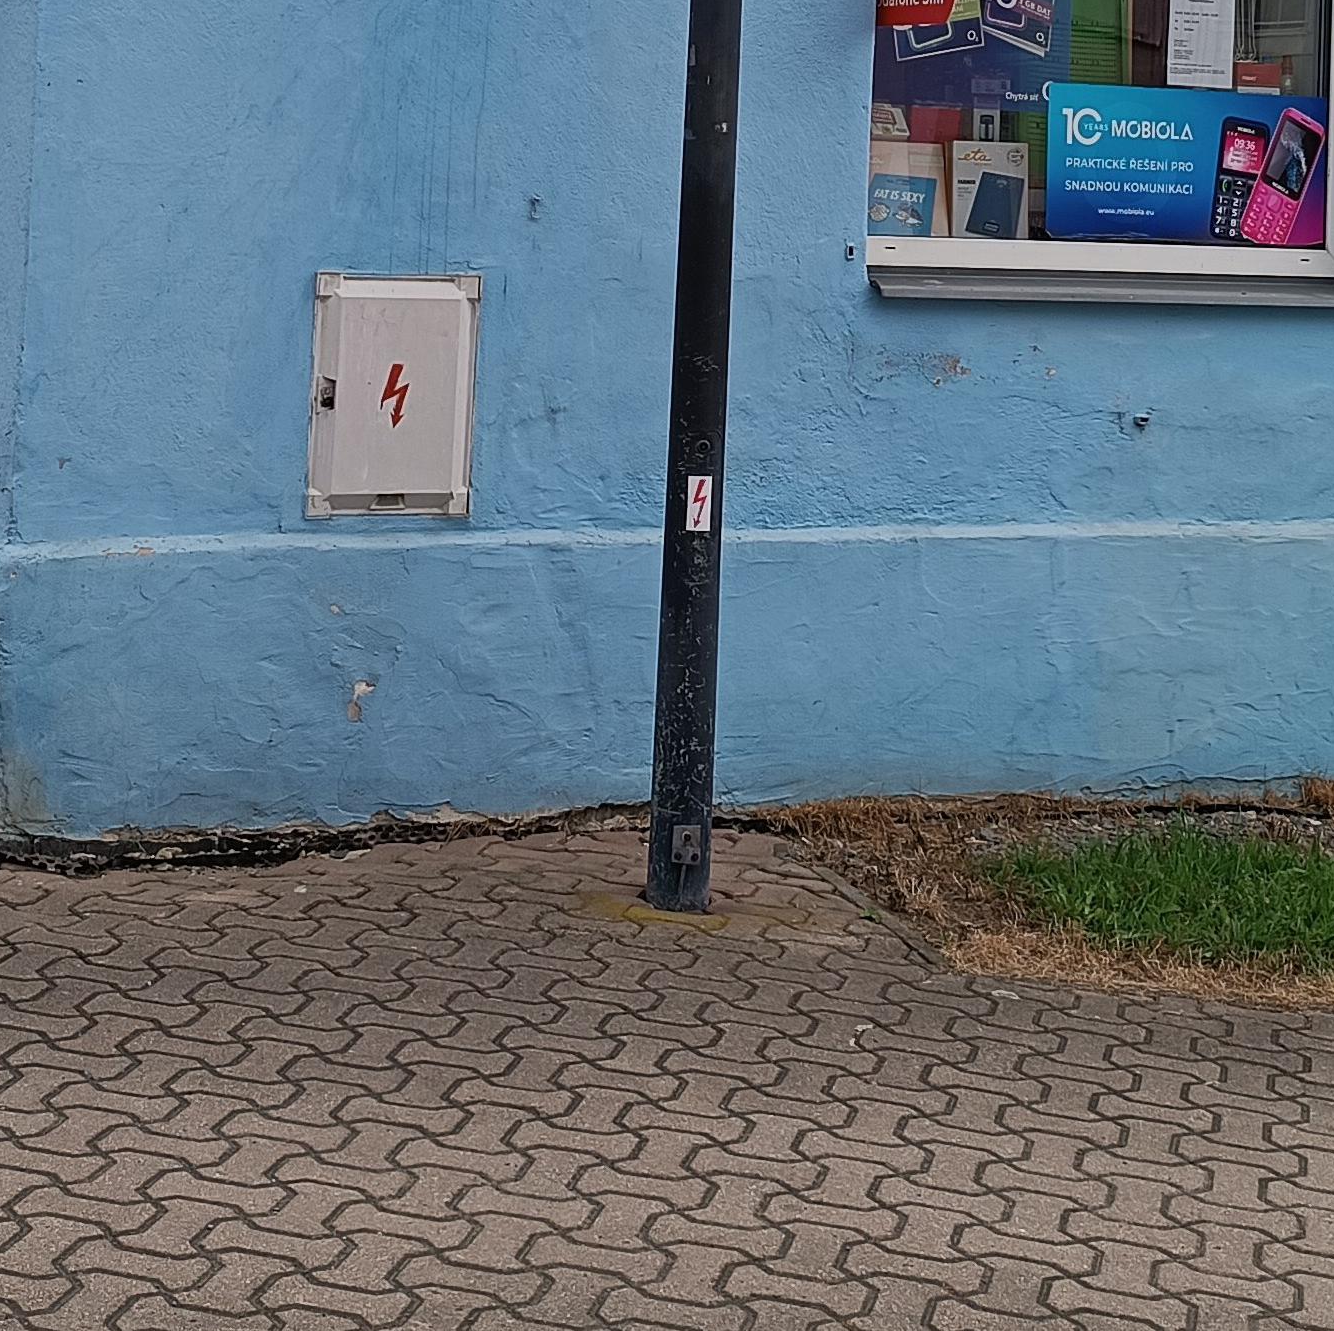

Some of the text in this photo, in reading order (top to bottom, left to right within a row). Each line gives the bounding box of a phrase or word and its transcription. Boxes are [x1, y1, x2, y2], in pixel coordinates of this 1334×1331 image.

[1062, 107, 1194, 146] 10 MOBIOLA
[1084, 123, 1109, 132] YEARS
[957, 148, 993, 162] eta
[1065, 156, 1194, 172] PRAKTICKÉ ŘEŠENÍ PRO
[1065, 179, 1193, 195] SNADNOU KOMUNIKACI
